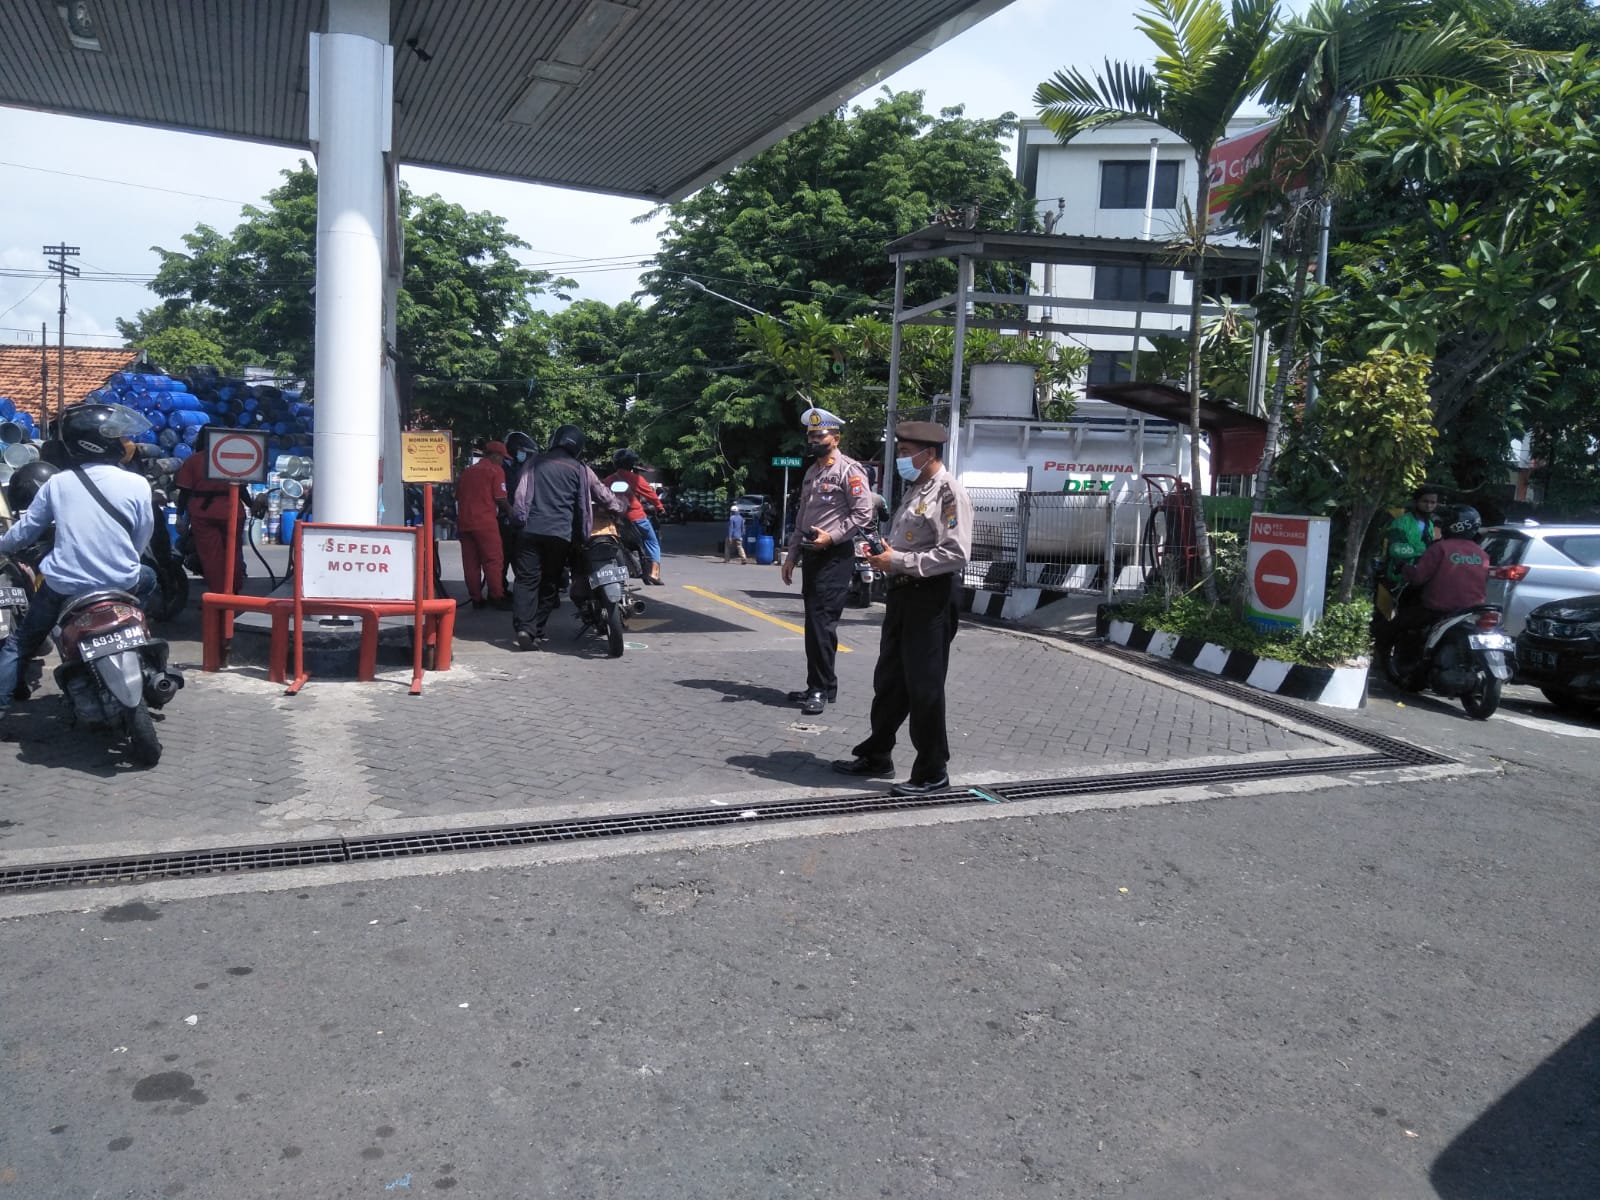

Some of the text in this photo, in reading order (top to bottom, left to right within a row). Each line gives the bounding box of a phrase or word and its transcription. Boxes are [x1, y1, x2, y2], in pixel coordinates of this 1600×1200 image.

[1044, 461, 1134, 473] PERTAMINA
[1064, 479, 1114, 492] DEX
[991, 505, 1015, 513] LITER
[1254, 522, 1272, 536] NO
[325, 538, 392, 555] SEPEDA
[1449, 552, 1483, 566] Grab
[328, 560, 389, 573] MOTOR
[80, 641, 91, 652] L
[92, 632, 122, 648] 6935
